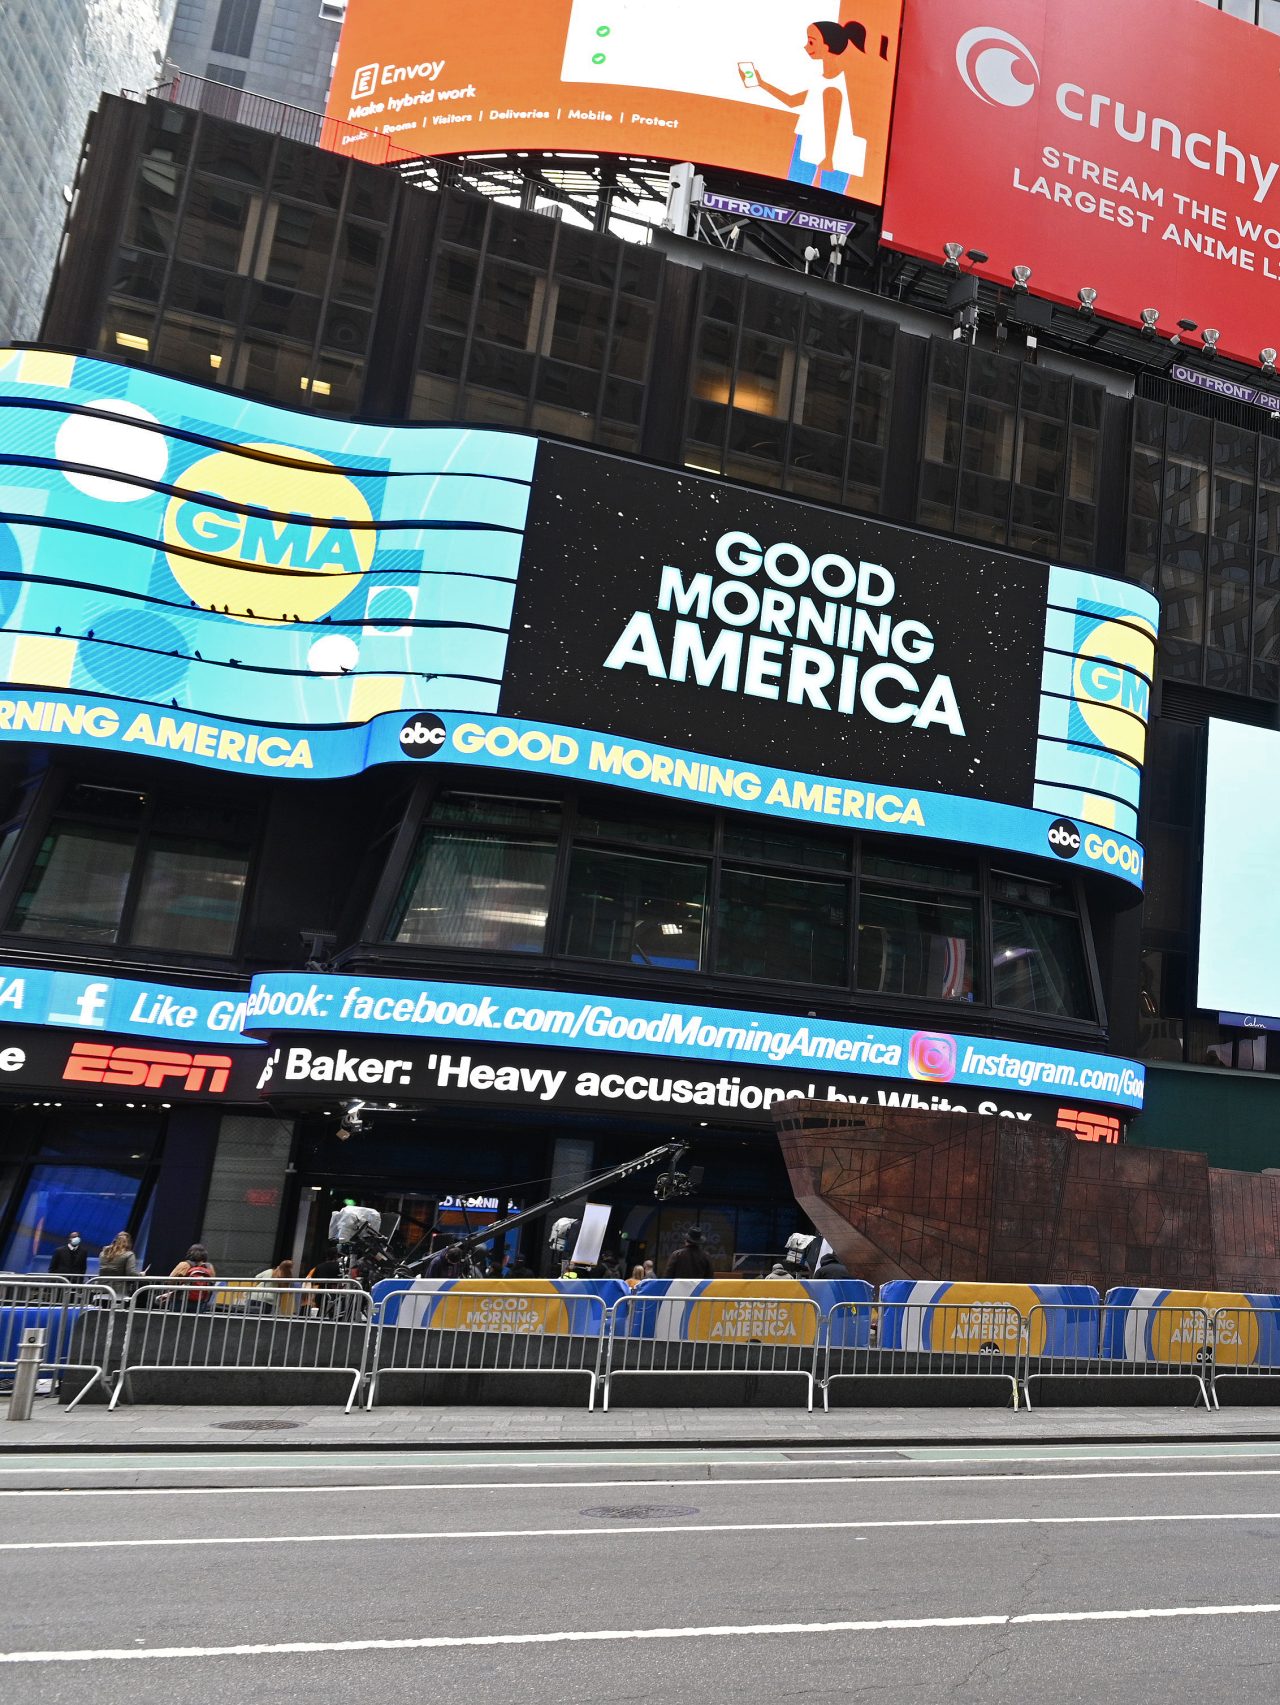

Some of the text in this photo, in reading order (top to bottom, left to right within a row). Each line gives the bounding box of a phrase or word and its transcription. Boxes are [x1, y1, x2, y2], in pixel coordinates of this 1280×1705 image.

[381, 60, 446, 86] Envoy
[347, 84, 477, 121] Make hybrid work
[382, 120, 417, 135] Rooms
[432, 113, 472, 125] Visitors
[489, 109, 550, 121] Deliveries
[568, 109, 613, 122] Mobile
[631, 113, 679, 129] Protect
[1042, 146, 1164, 208] STREAM
[1173, 193, 1227, 231] THE
[704, 193, 848, 234] UTFRONT PRIME
[1012, 167, 1154, 236] LARGEST
[1161, 223, 1254, 272] ANIME
[1176, 368, 1252, 400] OUTFRONT
[174, 488, 360, 574] GMA
[716, 531, 895, 607] GOOD
[657, 565, 935, 665] MORNING
[602, 610, 967, 737] AMERICA
[1079, 654, 1149, 721] GM
[123, 714, 314, 769] AMERICA
[400, 723, 925, 827] abc GOOD MORNING AMERICA
[1048, 826, 1139, 875] abc GOOD
[129, 992, 197, 1028] Like
[1243, 1015, 1267, 1029] Calm
[338, 986, 903, 1067] facebook.com/GoodMorningAmerica
[961, 1046, 1145, 1098] Instagram.com/Goo
[62, 1042, 232, 1093] ESPN
[285, 1047, 413, 1085] Baker:
[428, 1054, 566, 1101] 'Heavy
[466, 1311, 539, 1324] MORNING
[480, 1298, 528, 1311] GOOD
[722, 1308, 789, 1321] MORNING
[960, 1313, 1019, 1325] MORNING
[711, 1321, 797, 1337] AMERICA
[951, 1324, 1028, 1340] AMERICA
[1171, 1329, 1242, 1345] AMERICA
